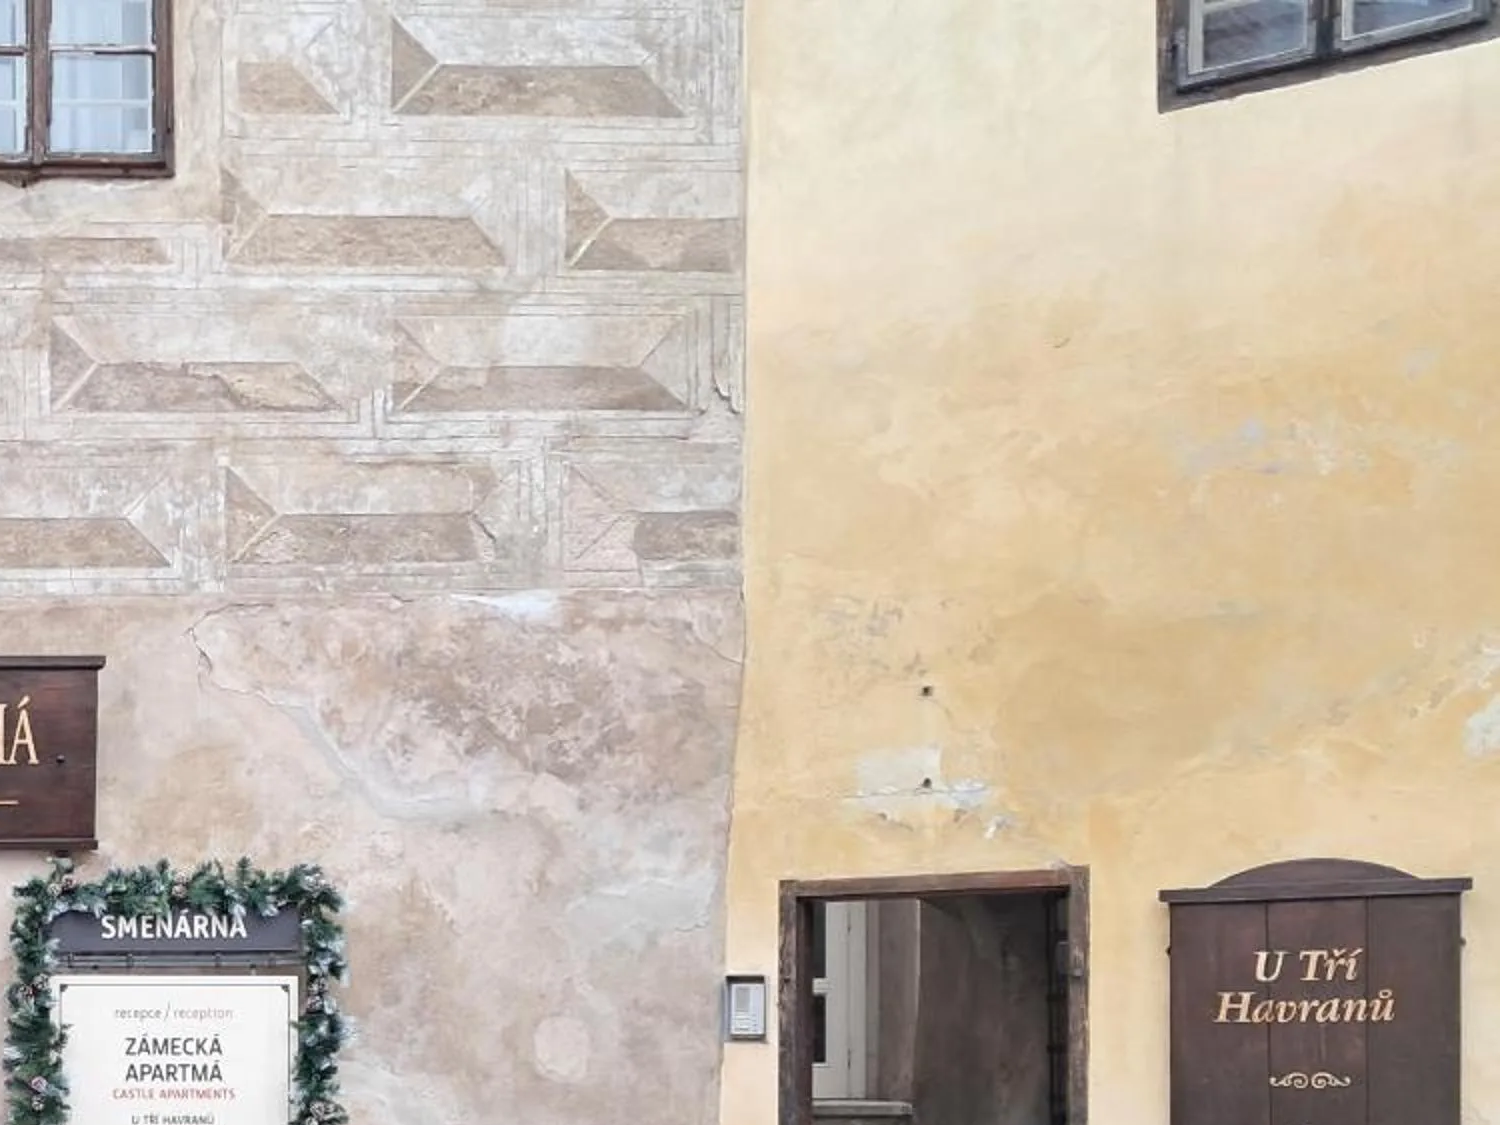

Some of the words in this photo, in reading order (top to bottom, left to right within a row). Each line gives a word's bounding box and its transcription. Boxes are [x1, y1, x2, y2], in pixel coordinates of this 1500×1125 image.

[1253, 951, 1294, 982] U
[1300, 948, 1364, 981] Tří
[115, 1009, 161, 1021] recepce
[174, 1006, 234, 1021] reception
[1213, 989, 1396, 1023] Havranů
[125, 1033, 222, 1056] ZÁMECKÁ
[125, 1059, 222, 1082] APARTMÁ
[112, 1088, 153, 1099] CASTLE
[160, 1088, 235, 1099] APARTMENTS
